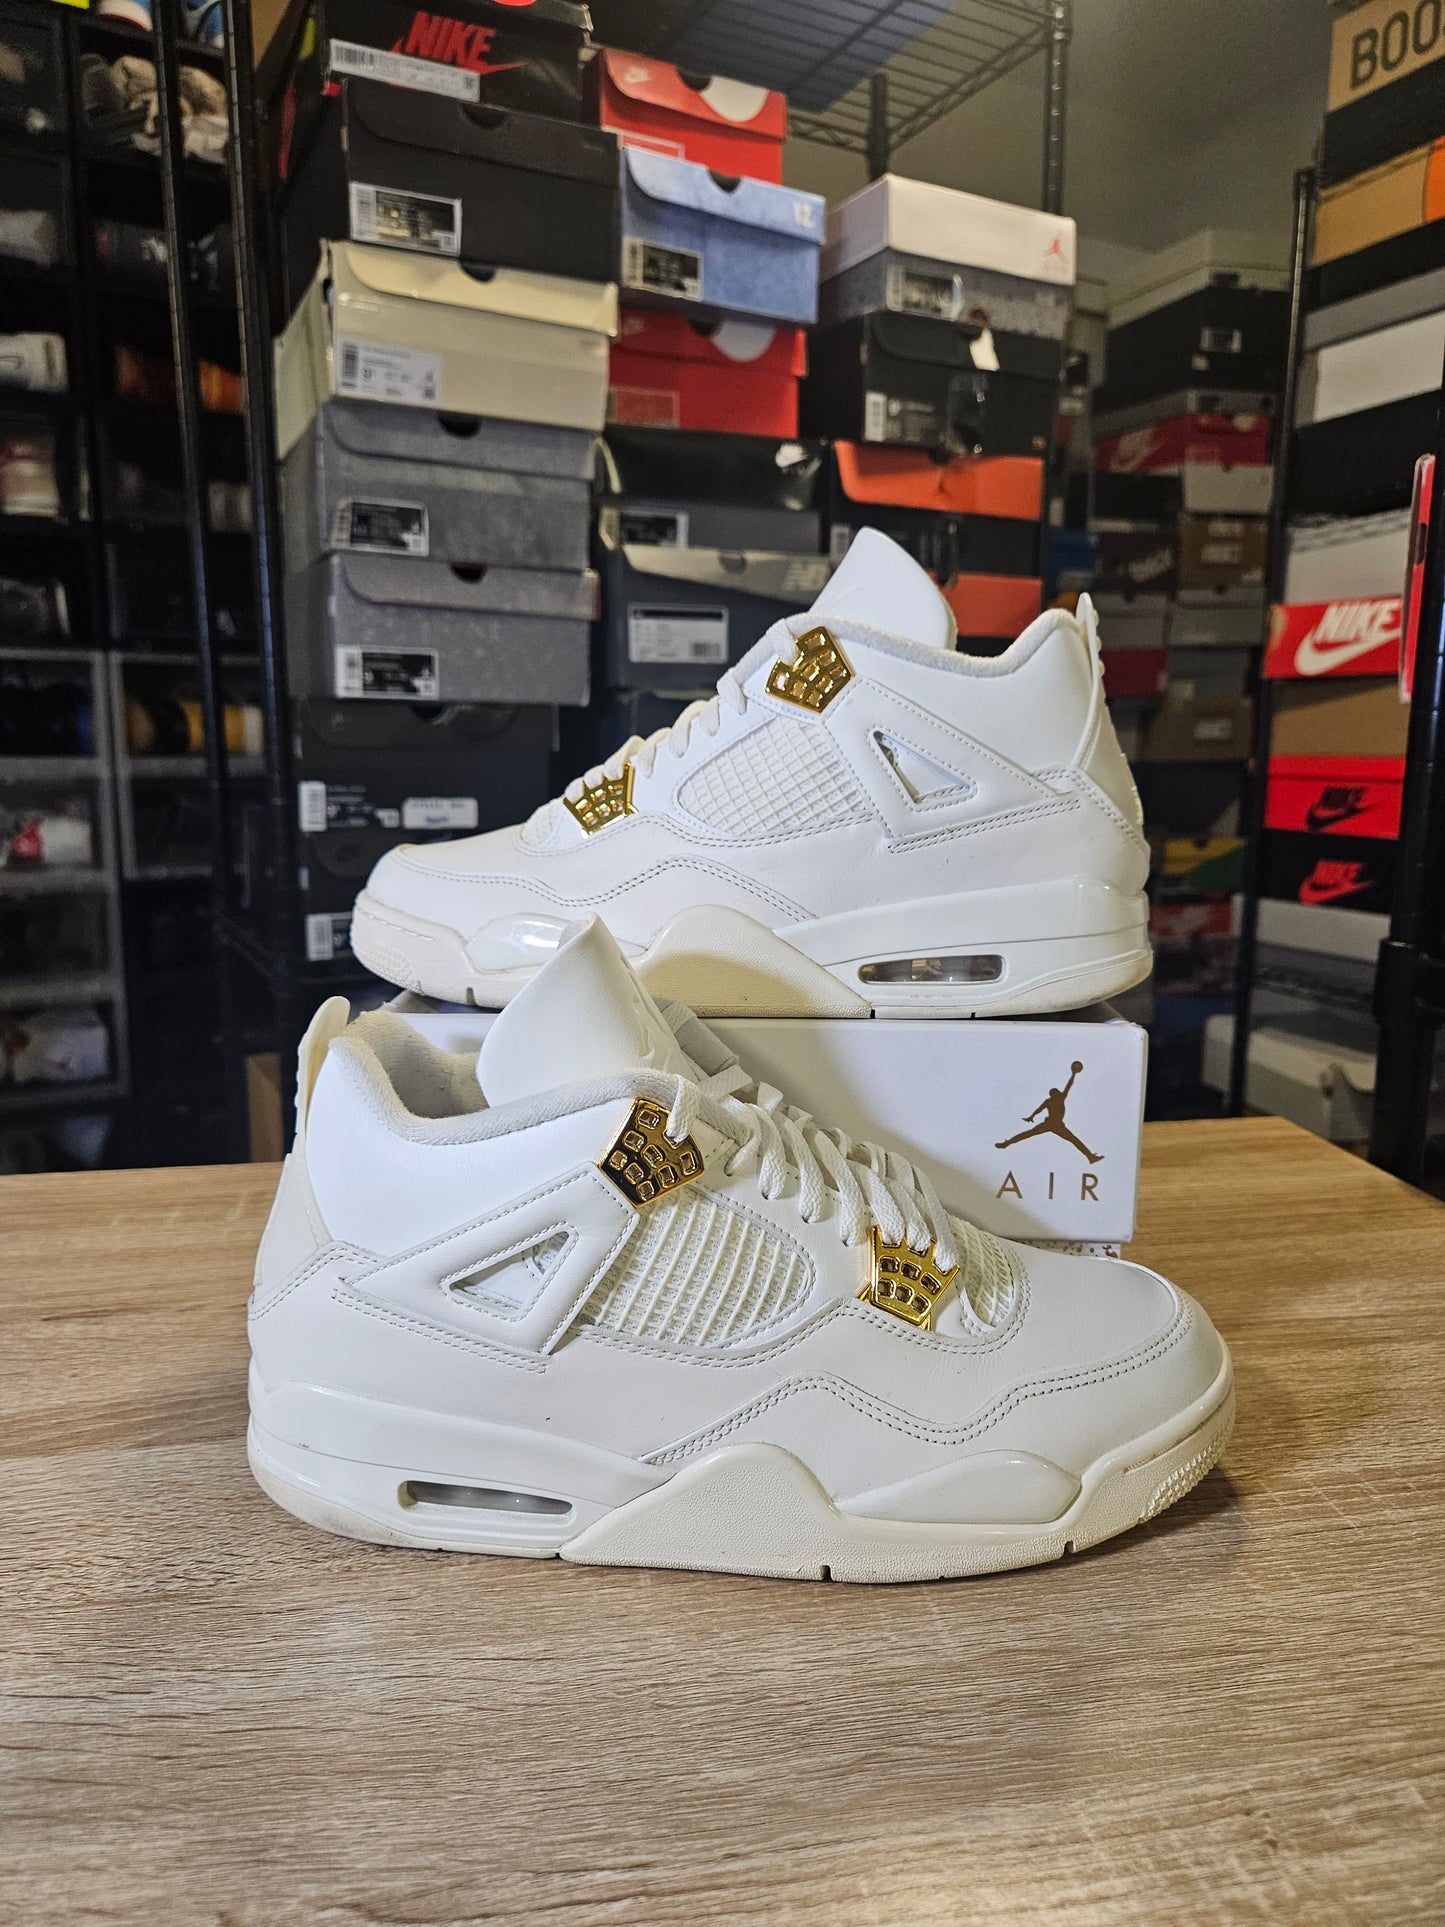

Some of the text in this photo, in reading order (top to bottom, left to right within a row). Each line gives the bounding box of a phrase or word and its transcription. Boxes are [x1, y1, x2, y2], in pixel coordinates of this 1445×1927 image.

[406, 11, 497, 68] NIKE
[1350, 0, 1445, 91] BOO
[1312, 598, 1402, 642] NIKE
[1317, 786, 1366, 810] NIKE
[1312, 860, 1364, 886] NIKE
[995, 1170, 1099, 1201] AIR
